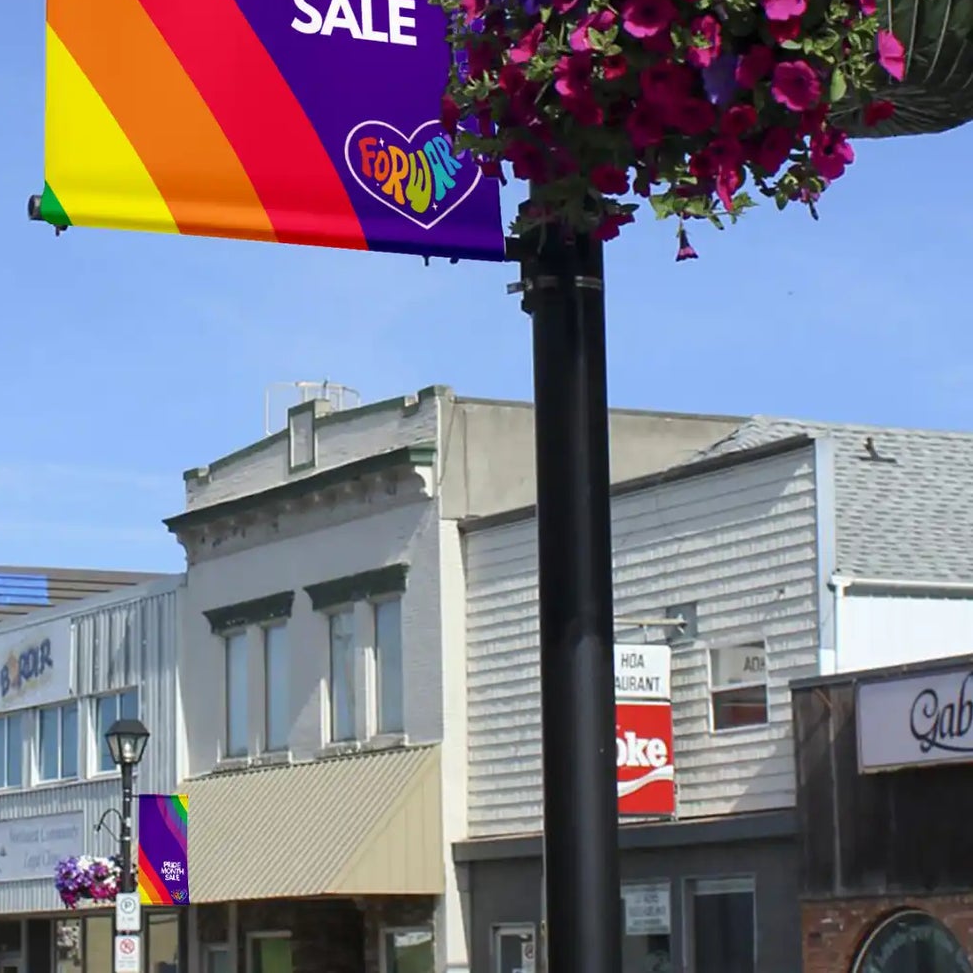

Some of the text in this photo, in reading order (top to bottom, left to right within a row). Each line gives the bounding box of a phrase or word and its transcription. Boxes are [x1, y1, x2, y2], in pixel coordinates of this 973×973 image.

[621, 653, 645, 668] HOA
[161, 867, 185, 875] MONTH
[165, 874, 181, 882] SALE
